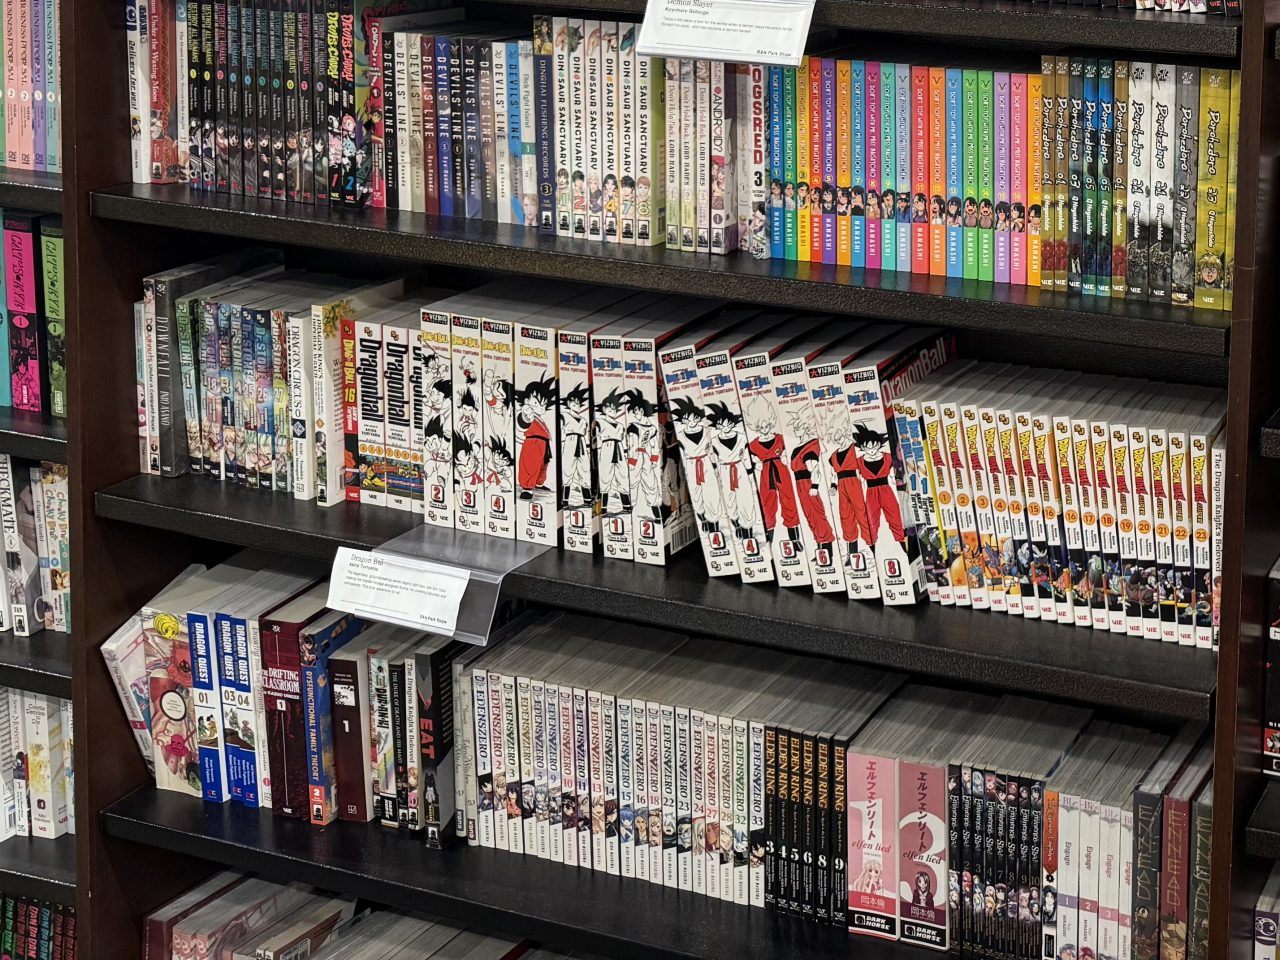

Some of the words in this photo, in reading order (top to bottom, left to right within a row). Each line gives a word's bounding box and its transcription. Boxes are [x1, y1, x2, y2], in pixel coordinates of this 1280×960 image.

[693, 0, 713, 8] Slayer
[531, 504, 539, 517] 5
[268, 667, 299, 681] DRIFTING
[198, 693, 208, 704] 01
[420, 718, 435, 760] EAT
[852, 840, 873, 850] elfen
[875, 842, 891, 853] lied
[834, 858, 843, 871] 9
[865, 921, 890, 930] HORSE
[866, 916, 886, 925] DARK
